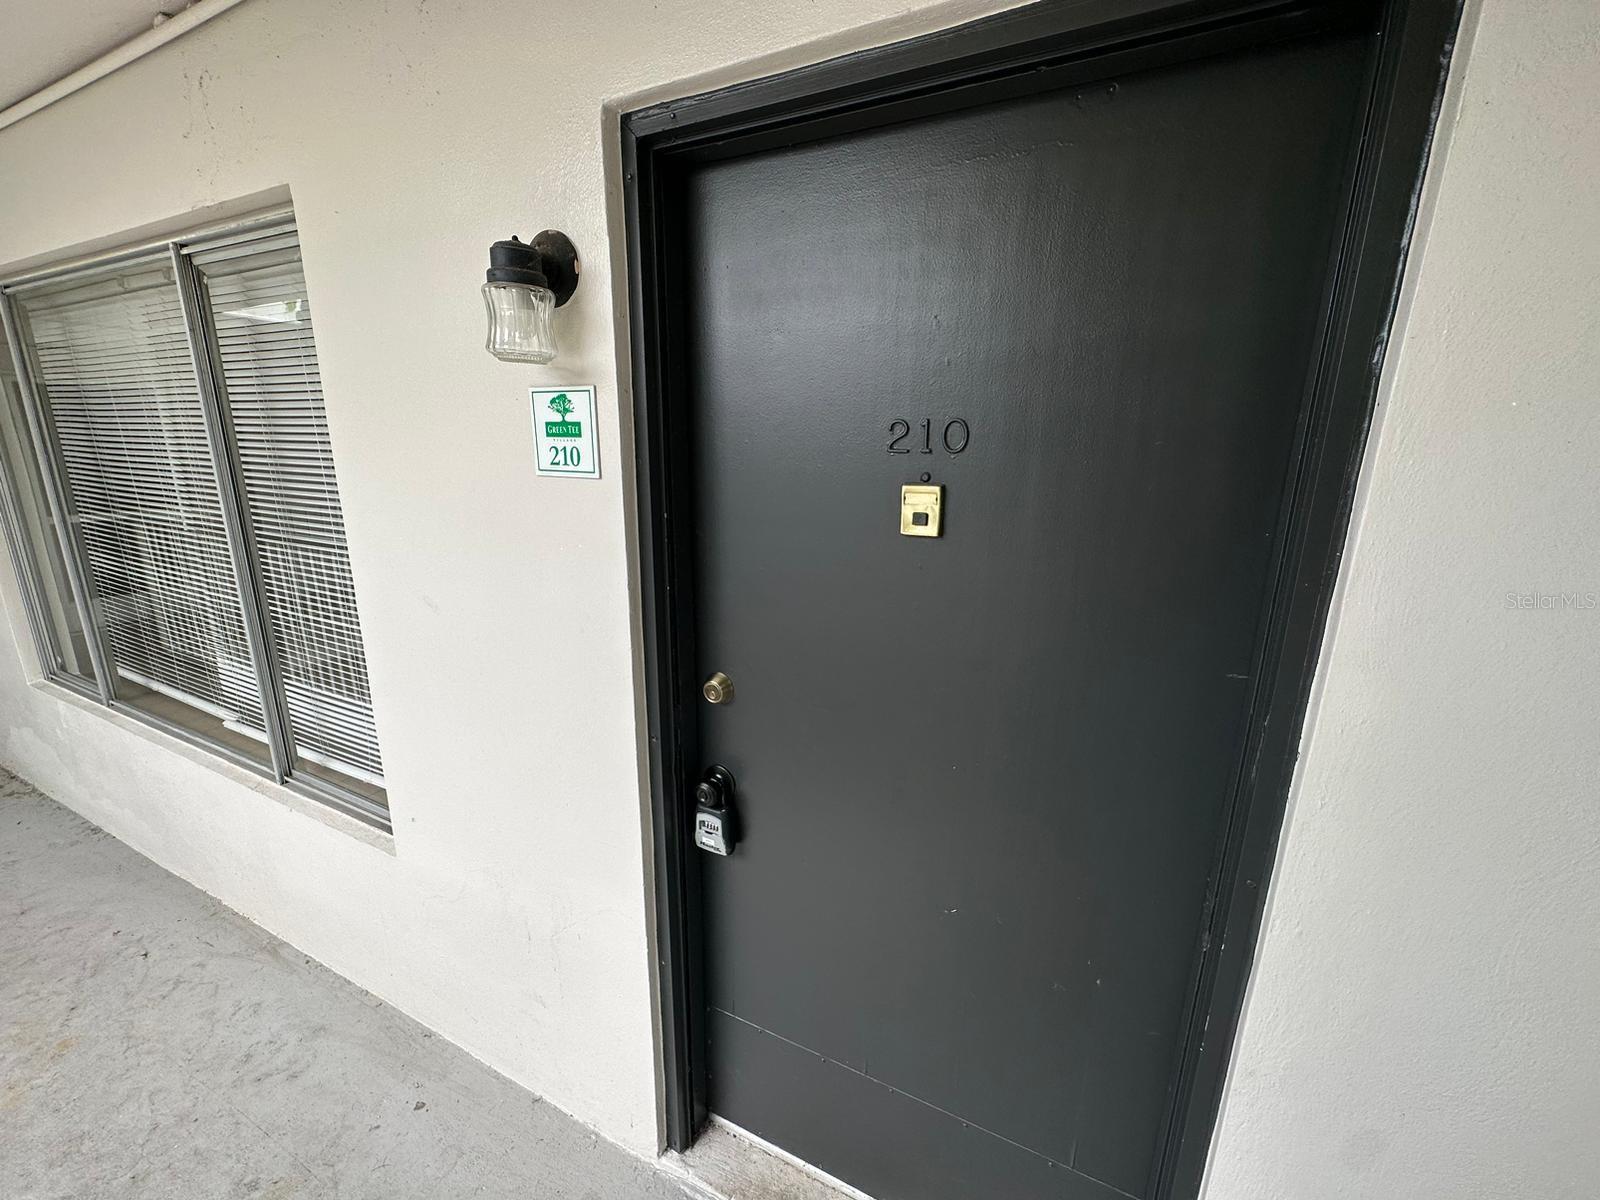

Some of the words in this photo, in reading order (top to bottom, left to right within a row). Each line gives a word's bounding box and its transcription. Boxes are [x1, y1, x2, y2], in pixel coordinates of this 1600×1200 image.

[547, 424, 567, 434] GREEN
[568, 425, 580, 434] TEE
[887, 418, 970, 454] 210
[549, 446, 581, 467] 210
